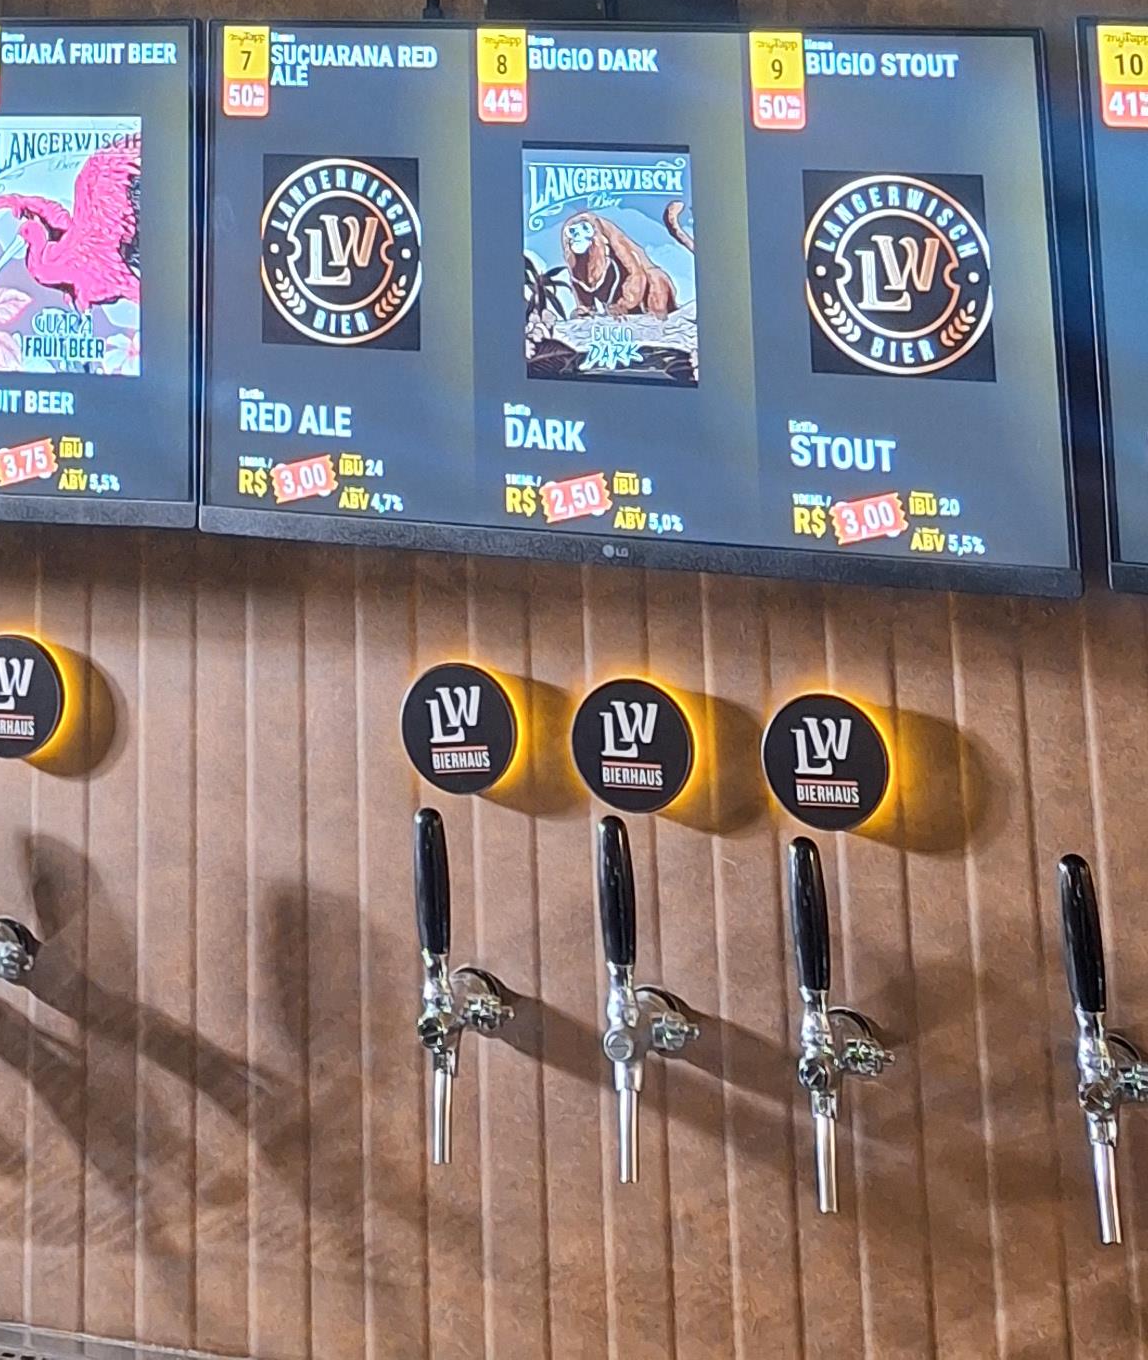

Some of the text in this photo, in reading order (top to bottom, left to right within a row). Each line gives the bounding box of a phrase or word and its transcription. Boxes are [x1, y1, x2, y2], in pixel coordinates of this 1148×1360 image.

[1, 38, 177, 64] GUARÁ FRUIT BEER
[240, 50, 252, 71] 7
[397, 45, 438, 68] RED
[528, 48, 658, 72] BUGIO DARK
[270, 67, 309, 86] ALE
[497, 54, 508, 75] 8
[771, 59, 783, 80] 9
[806, 52, 959, 78] BUGIO STOUT
[1114, 53, 1143, 76] 10
[270, 168, 412, 236] LANGERWISCH
[815, 186, 979, 259] LANGERWISCH
[304, 214, 378, 286] LW
[854, 235, 940, 312] LW
[313, 309, 369, 335] BIER
[25, 336, 105, 359] FRUIT BEER
[588, 344, 640, 360] DARK
[870, 336, 935, 364] BIER
[24, 390, 75, 415] BEER
[239, 401, 352, 438] RED ALE
[504, 417, 586, 453] DARK
[59, 441, 83, 458] IBU
[789, 435, 896, 472] STOUT
[3, 445, 47, 480] 3,75
[338, 458, 383, 476] IBU 24
[58, 473, 120, 493] ABV 5,5%
[238, 463, 327, 498] R$ 3,00
[613, 476, 640, 495] IBU
[338, 491, 403, 513] ABV 4,7%
[505, 481, 600, 517] R$ 2,50
[909, 496, 960, 517] IBU 20
[613, 511, 684, 534] ABV 5,0%
[793, 501, 896, 538] R$ 3,00
[615, 547, 629, 557] LG
[910, 532, 986, 556] ABV 5,5%
[425, 685, 481, 744] LW
[599, 701, 658, 758] LW
[791, 717, 852, 775] LW
[432, 751, 490, 770] BIERHAUS
[602, 766, 663, 787] BIERHAUS
[796, 784, 860, 804] BIERHAUS
